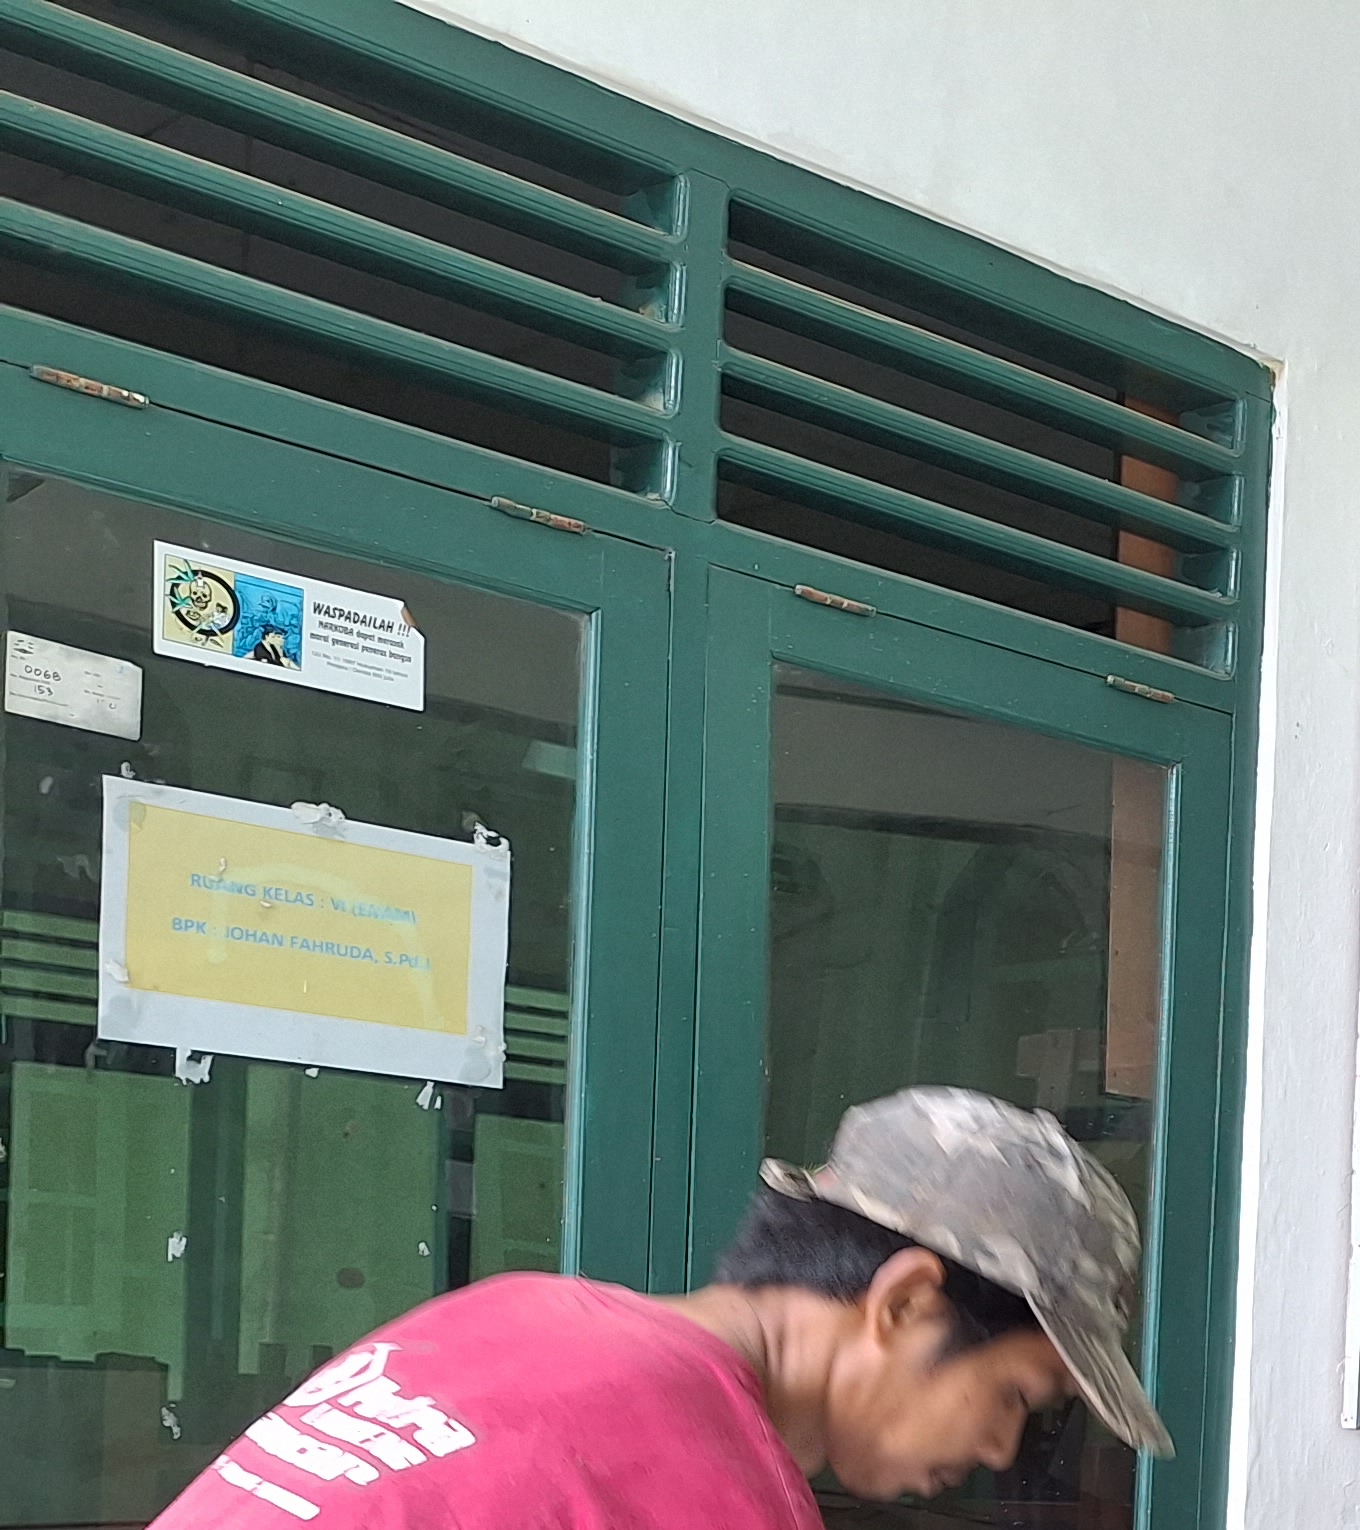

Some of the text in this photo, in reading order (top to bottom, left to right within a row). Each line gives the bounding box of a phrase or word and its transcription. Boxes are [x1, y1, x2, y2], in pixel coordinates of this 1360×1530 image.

[313, 601, 395, 633] WASPADAILAH
[262, 886, 315, 907] KELAS
[171, 917, 207, 935] BPK
[225, 926, 285, 947] JOHAN
[289, 936, 380, 964] FAHRUDA,
